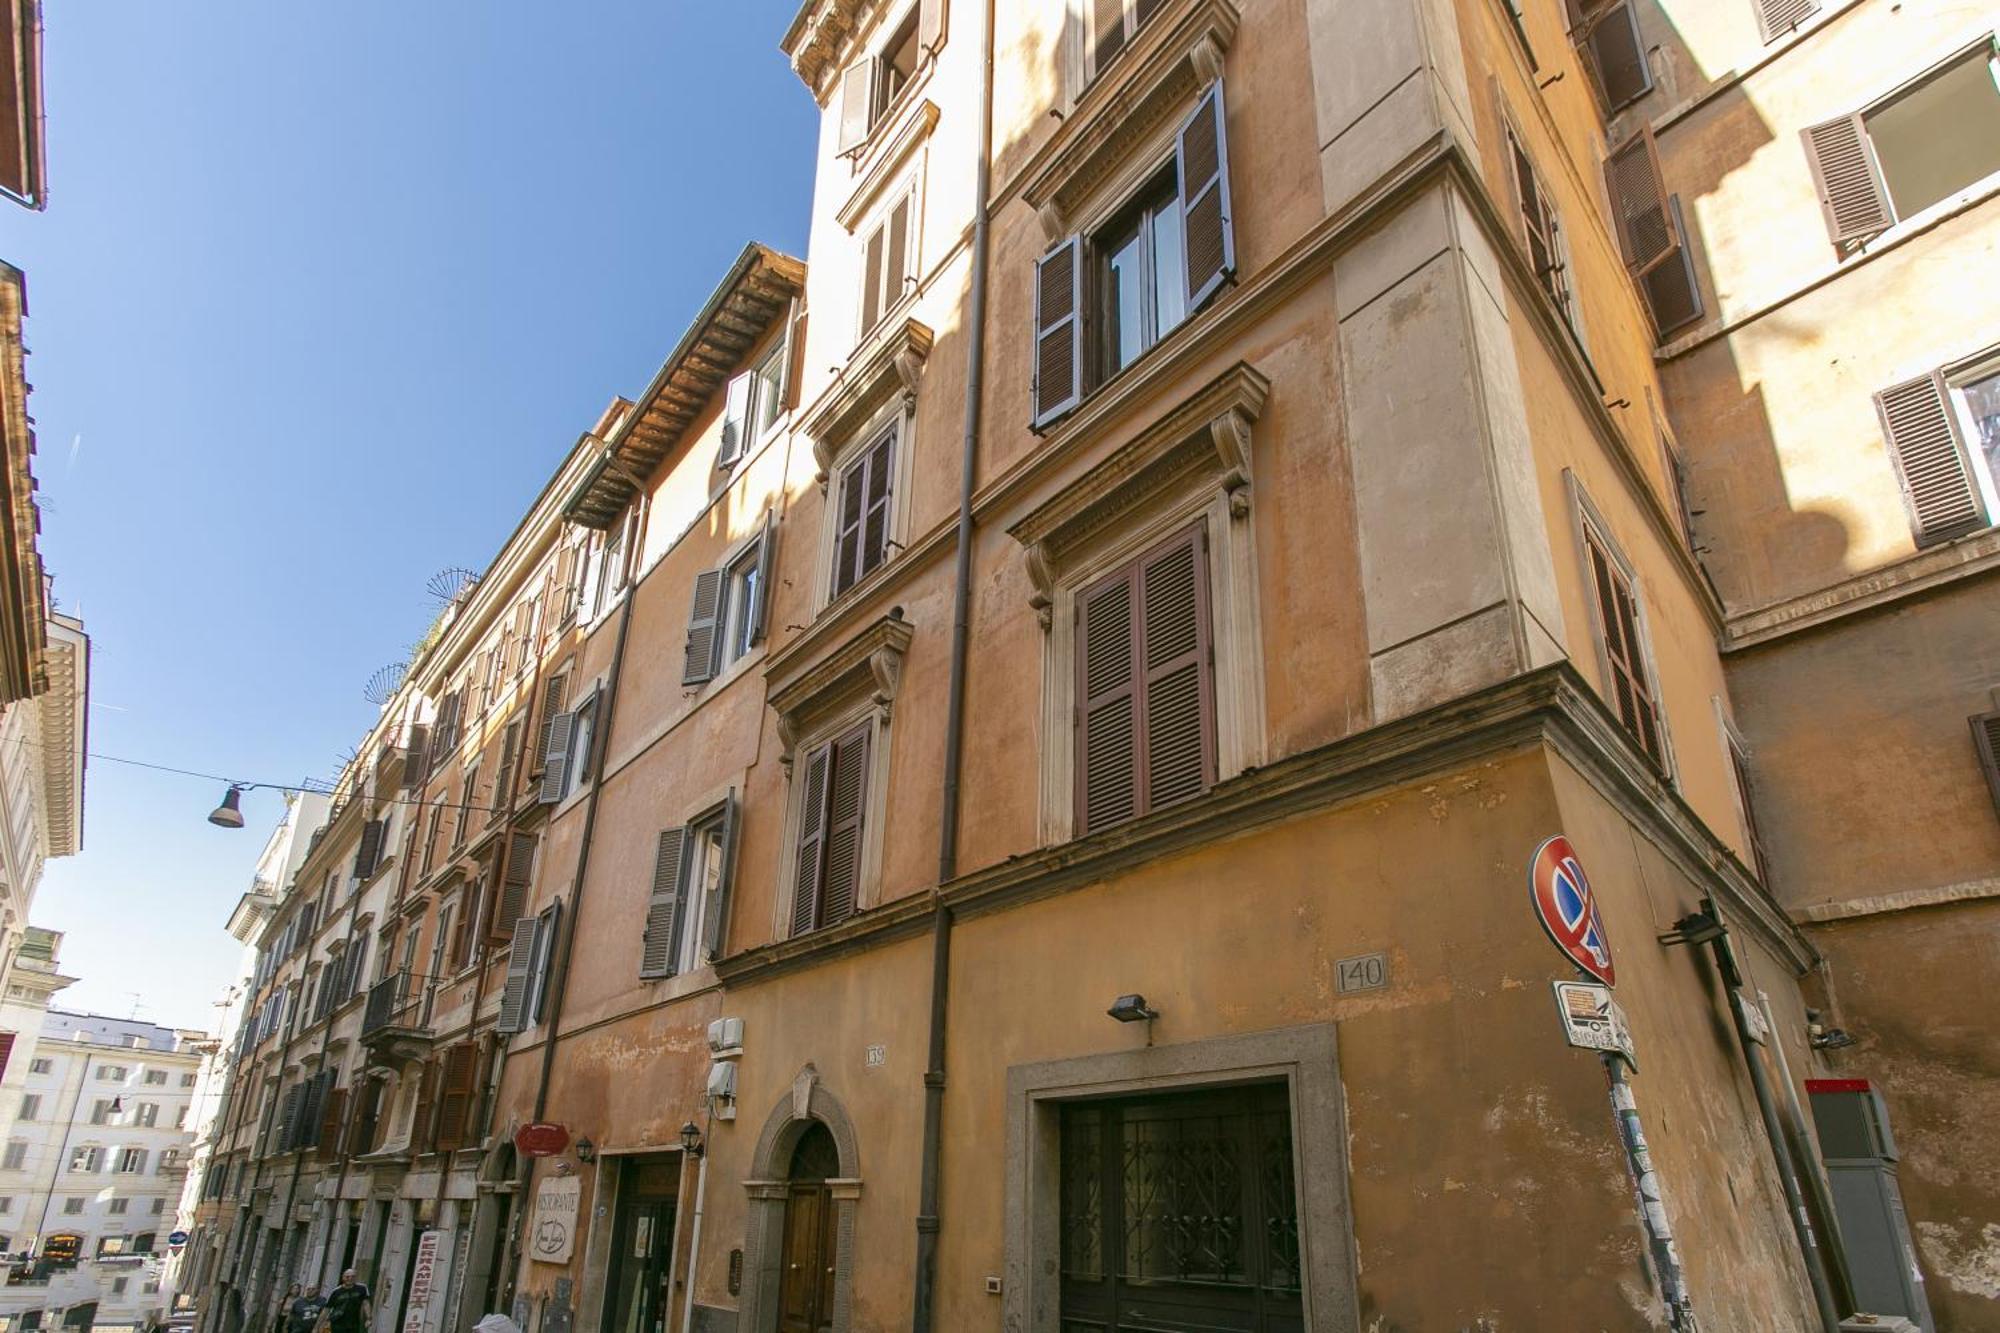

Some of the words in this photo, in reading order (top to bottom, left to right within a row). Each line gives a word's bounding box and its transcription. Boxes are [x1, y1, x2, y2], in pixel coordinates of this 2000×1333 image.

[1339, 957, 1382, 991] 140
[866, 1047, 885, 1065] 139
[409, 1235, 437, 1309] FERRAMENTA
